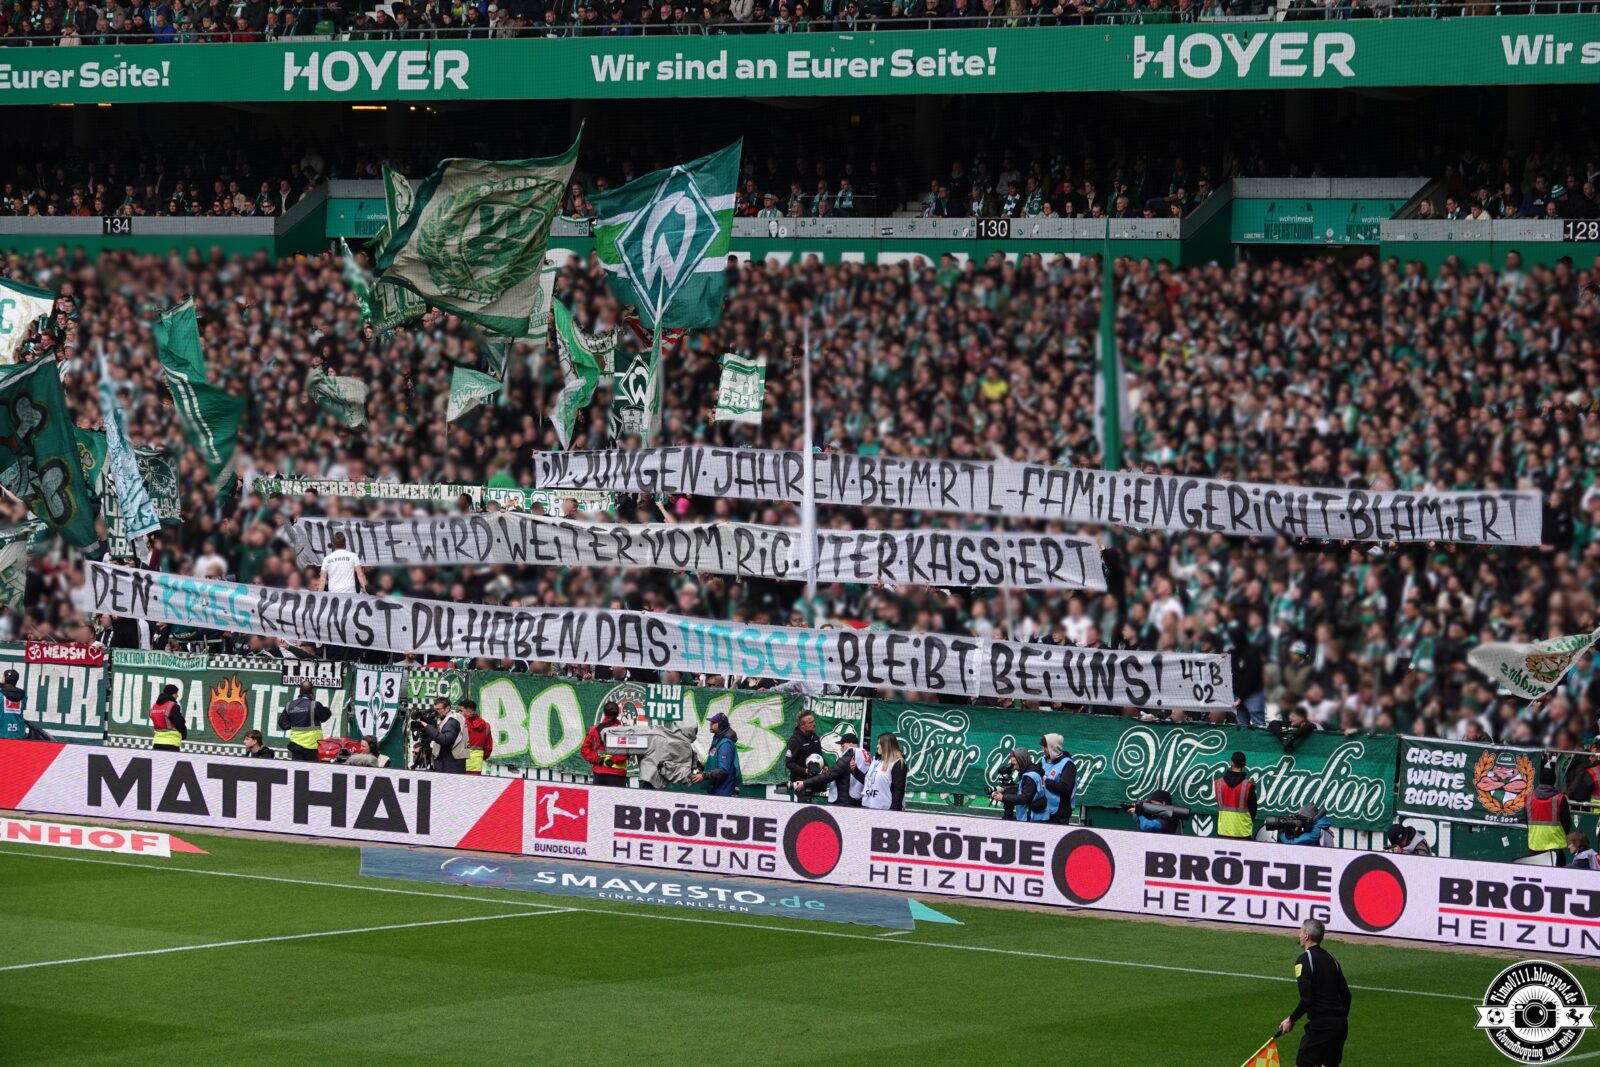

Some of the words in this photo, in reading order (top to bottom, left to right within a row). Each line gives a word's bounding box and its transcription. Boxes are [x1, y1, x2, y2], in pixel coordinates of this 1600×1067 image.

[1133, 32, 1356, 79] HOYER
[1501, 34, 1573, 65] Wir
[0, 64, 75, 89] Eurer
[79, 61, 170, 88] Seite!
[284, 50, 470, 91] HOYER
[590, 54, 650, 82] Wir
[656, 50, 728, 80] sind
[735, 57, 778, 79] an
[787, 50, 885, 78] Eurer
[889, 47, 998, 77] Seite!
[105, 218, 130, 233] 134
[979, 219, 1008, 238] 130
[1279, 215, 1313, 223] wohninvest
[1566, 221, 1599, 241] 128
[573, 446, 701, 492] JUNGEN
[712, 450, 852, 501] JAHREN
[641, 524, 724, 571] VOM
[89, 564, 151, 617] DEN
[256, 588, 404, 650] KANNST
[412, 602, 455, 652] DU
[600, 610, 671, 668] DAS
[42, 645, 86, 660] HERSH
[115, 651, 145, 665] SEKTION
[283, 659, 342, 678] TOBI
[409, 679, 450, 698] VEC
[647, 683, 681, 700] תמיד
[647, 702, 681, 719] ביחד
[8, 723, 18, 731] 25
[899, 710, 980, 785] Für
[1113, 727, 1385, 820] Wesstadion
[1406, 747, 1467, 768] GREEN
[1407, 768, 1465, 789] WHITE
[87, 754, 432, 835] MATTHÄI
[1404, 787, 1474, 810] BUDDIES
[0, 822, 159, 851] NHOF
[613, 803, 778, 843] BRÖTJE
[534, 843, 587, 856] BUNDESLIGA
[613, 840, 777, 873] HEIZUNG
[870, 826, 1046, 867] BRÖTJE
[869, 864, 1045, 897] HEIZUNG
[1144, 850, 1332, 892] BRÖTJE
[599, 892, 666, 905] EINFACH
[674, 899, 750, 912] ANLEGEN
[1143, 889, 1331, 925] HEIZUNG
